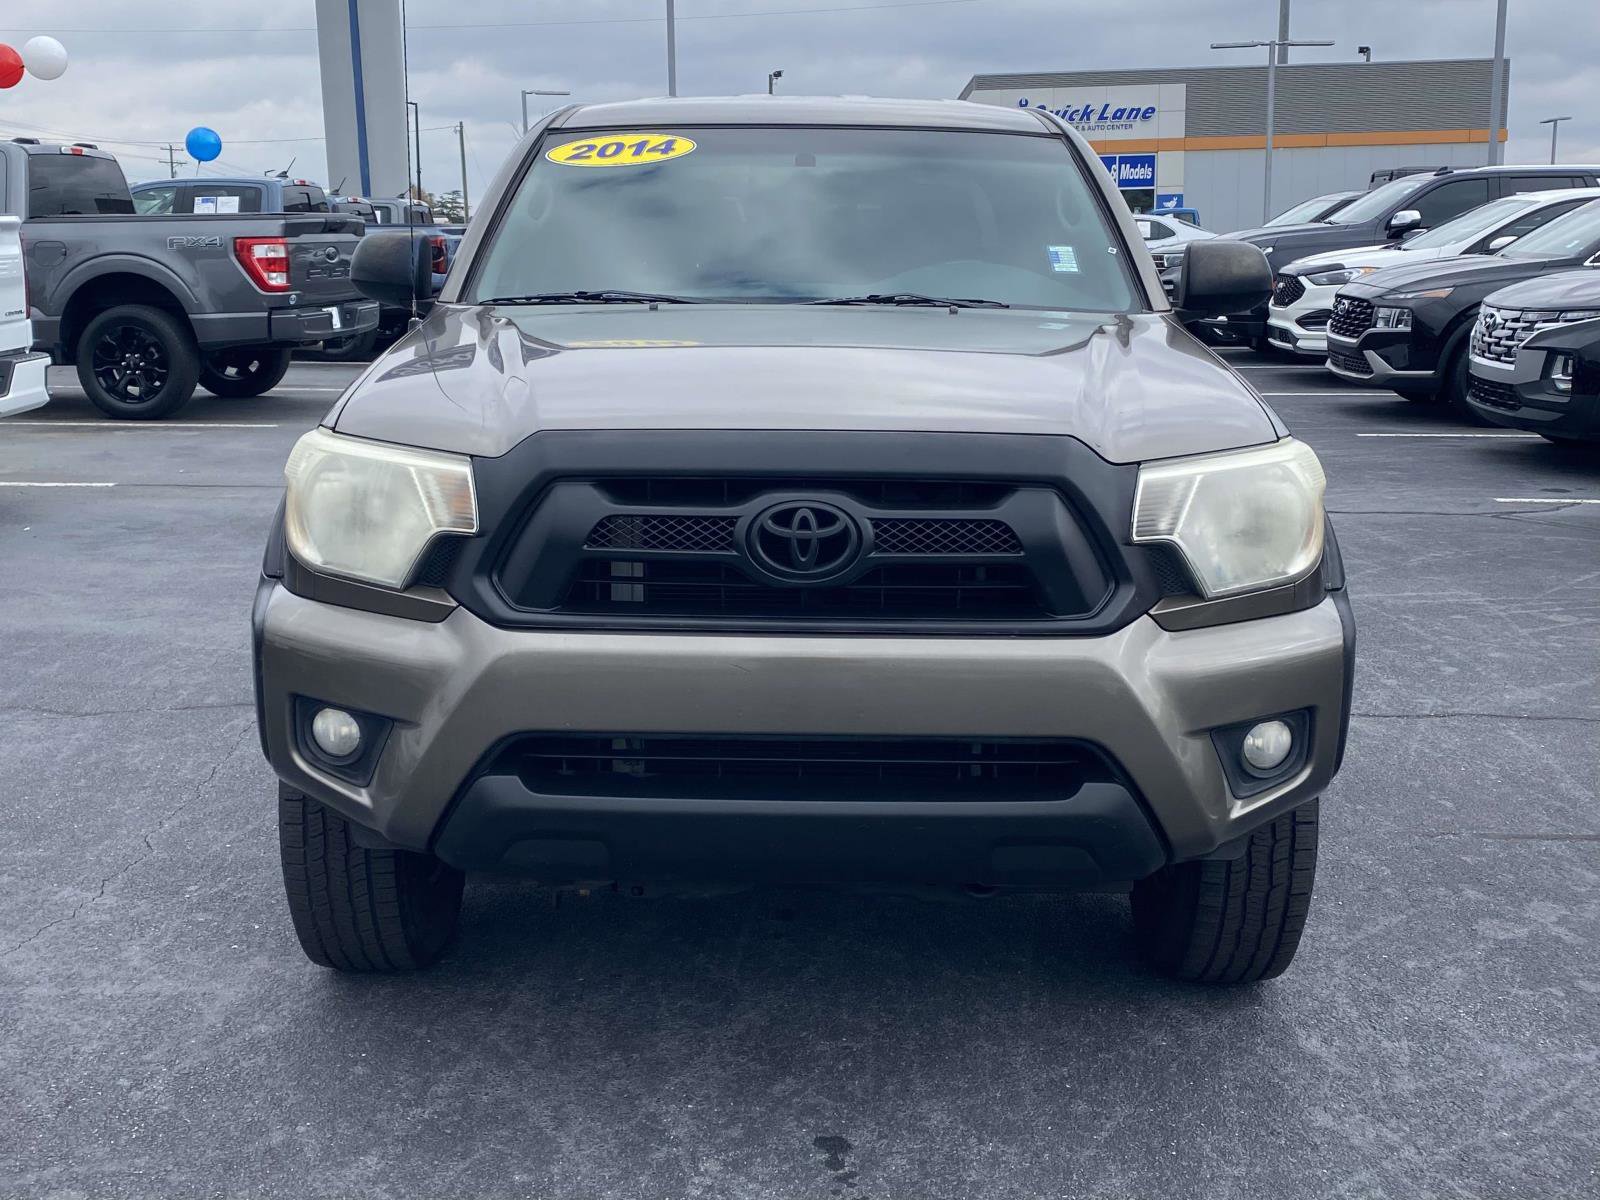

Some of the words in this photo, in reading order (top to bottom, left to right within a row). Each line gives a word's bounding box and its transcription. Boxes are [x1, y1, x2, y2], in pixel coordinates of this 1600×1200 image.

[1097, 103, 1156, 121] Lane
[564, 139, 677, 161] 2014
[1120, 163, 1152, 180] Models
[167, 236, 223, 251] FX4
